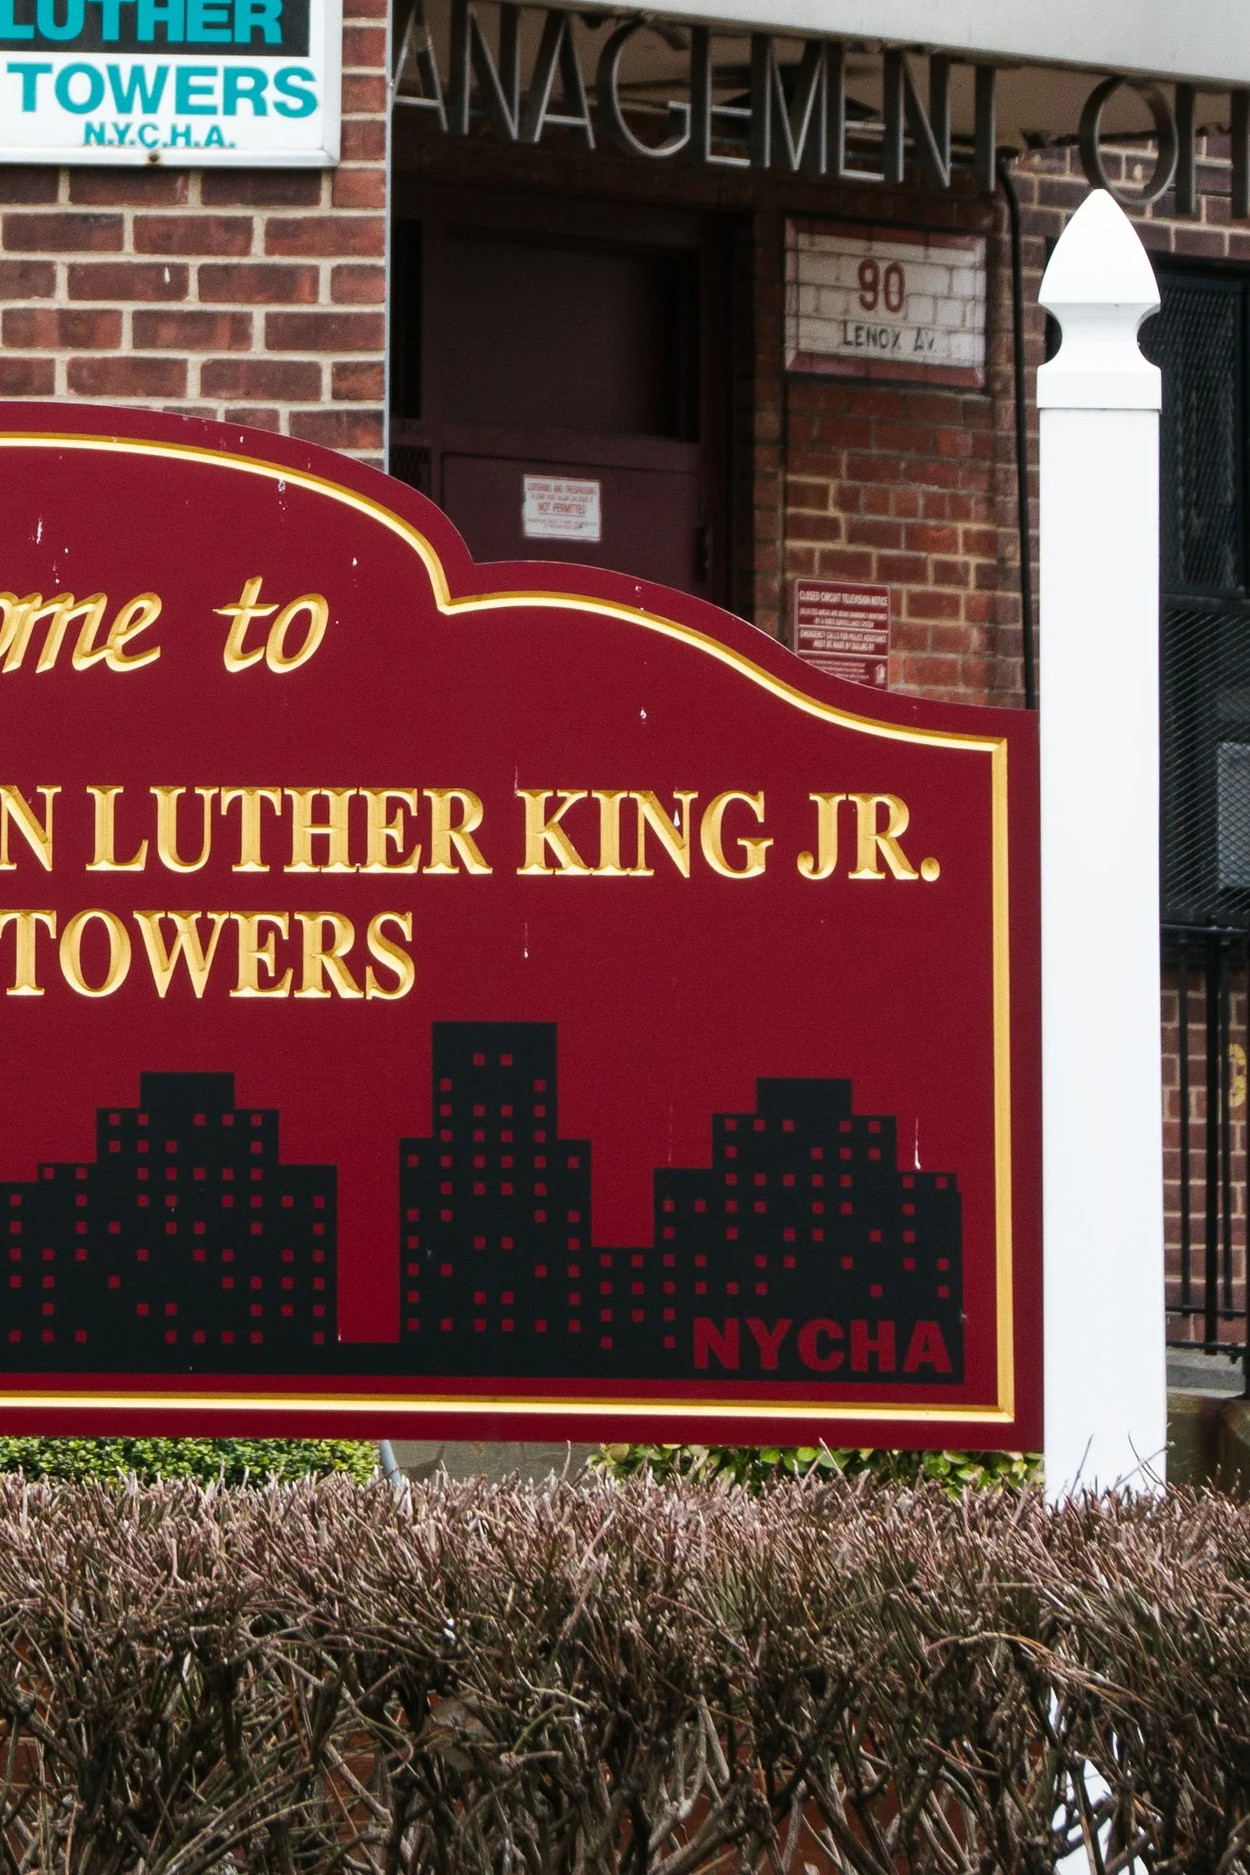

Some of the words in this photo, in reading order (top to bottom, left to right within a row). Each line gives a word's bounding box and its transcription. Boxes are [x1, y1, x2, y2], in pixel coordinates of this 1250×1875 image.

[7, 61, 319, 120] TOWERS
[83, 121, 236, 149] N.Y.C.H.A.
[858, 258, 906, 313] 90
[843, 320, 900, 350] LENOX
[212, 576, 329, 674] to
[85, 785, 493, 875] LUTHER
[514, 789, 774, 880] KING
[797, 792, 941, 882] JR.
[693, 1317, 953, 1373] NYCHA
